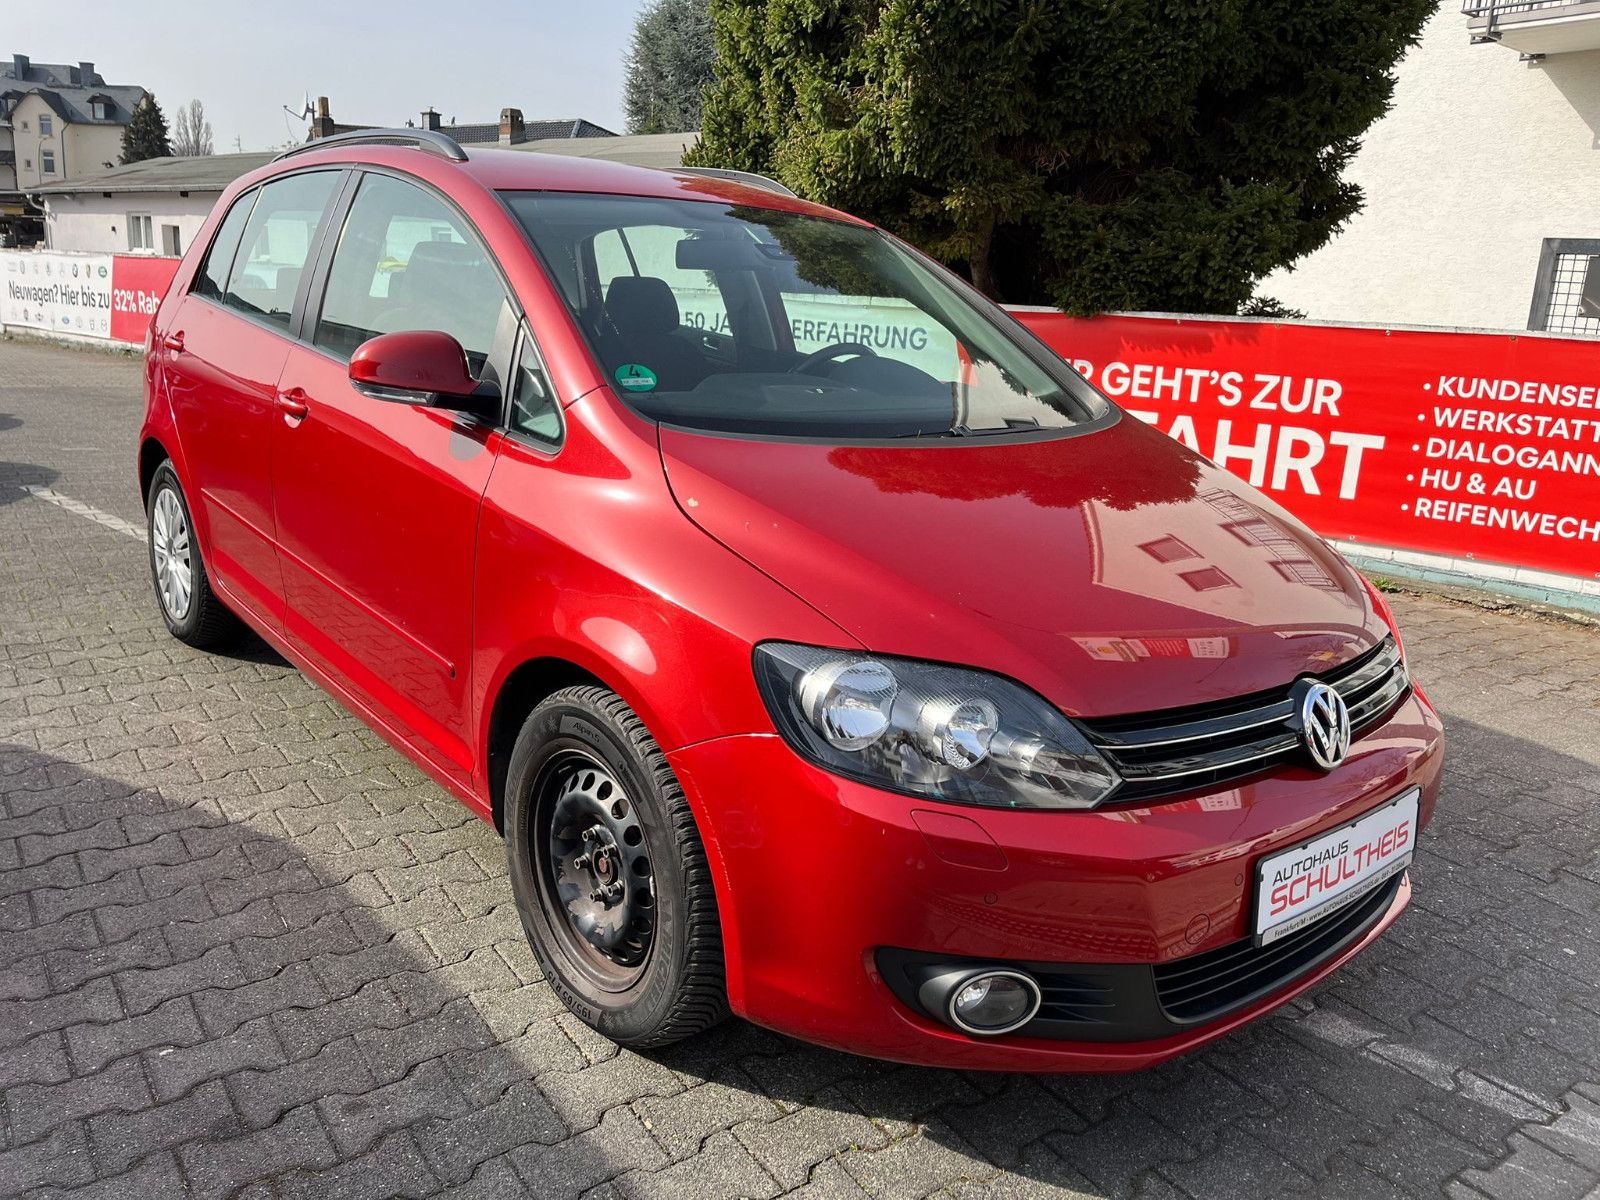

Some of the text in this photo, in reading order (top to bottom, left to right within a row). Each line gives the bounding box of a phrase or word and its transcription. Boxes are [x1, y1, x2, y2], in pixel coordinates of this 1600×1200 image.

[8, 280, 58, 307] Neuwagen?
[60, 285, 80, 306] Hier
[82, 287, 95, 309] bis
[98, 293, 110, 309] zu
[113, 289, 137, 313] 32%
[685, 311, 705, 329] 50
[792, 319, 928, 351] ERFAHRUNG
[629, 365, 641, 378] 4
[1250, 373, 1343, 416] ZUR
[1125, 409, 1386, 501] AHRT
[1419, 467, 1537, 501] HU & AU
[1414, 497, 1600, 542] REIFENWECH
[1270, 819, 1410, 917] SCHULTHEIS
[1272, 839, 1350, 887] AUTOHAUS
